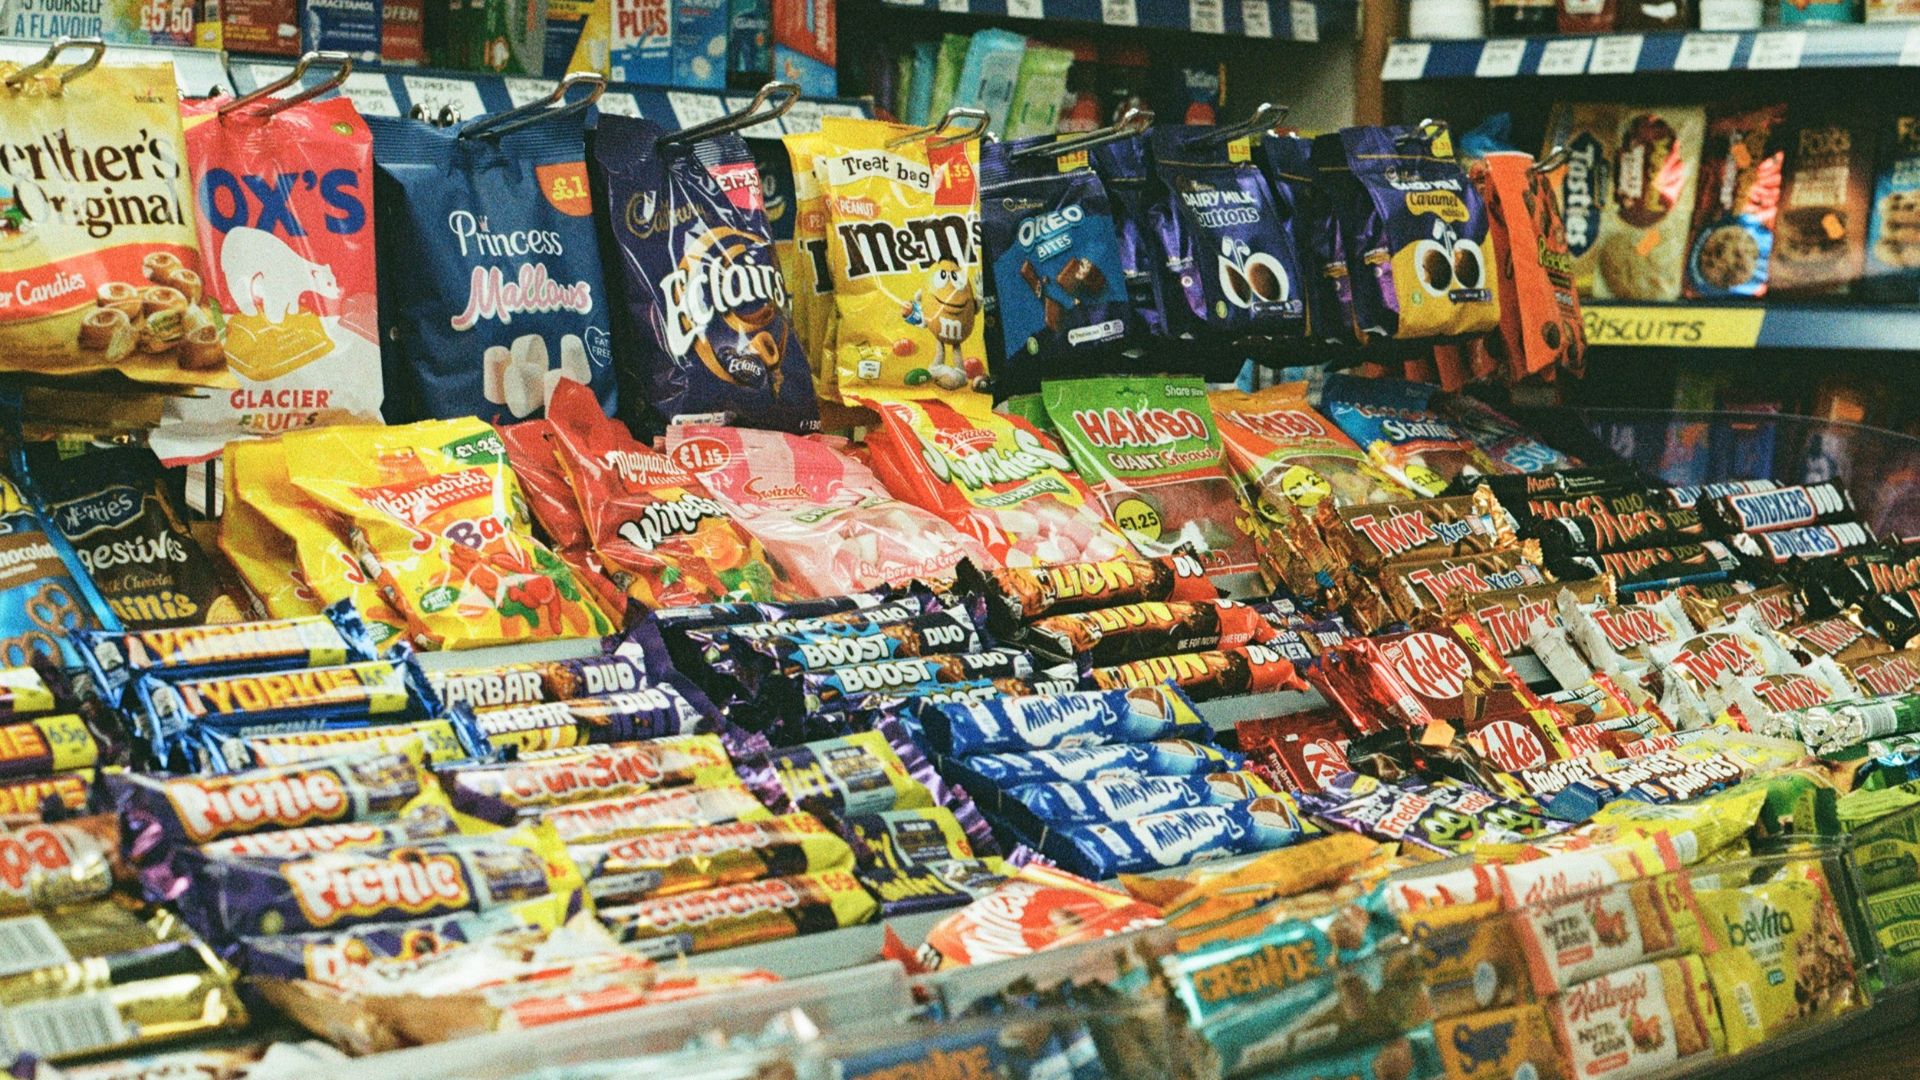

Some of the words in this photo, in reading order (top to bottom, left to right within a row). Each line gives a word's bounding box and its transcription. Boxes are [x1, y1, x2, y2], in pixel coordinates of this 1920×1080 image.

[14, 15, 24, 38] A
[31, 15, 103, 38] FLAVOUR
[618, 8, 668, 38] PLUS
[842, 156, 889, 176] Treat
[896, 163, 931, 188] bag
[551, 175, 588, 201] £1
[202, 169, 366, 237] OX'S
[840, 199, 875, 216] PEANUT
[448, 210, 563, 258] Princess
[1018, 203, 1084, 247] OREO
[1036, 234, 1073, 258] BITES
[16, 271, 87, 306] Candies
[451, 263, 593, 331] Mallows
[660, 254, 786, 355] Eclairs
[1583, 311, 1705, 342] BISCUITS
[728, 359, 762, 377] Eclairs
[230, 389, 330, 409] GLACIER
[1165, 385, 1191, 397] Share
[238, 410, 318, 433] FRUITS
[679, 443, 724, 469] £1.15
[1107, 453, 1165, 471] GIANT
[1735, 486, 1814, 529] SNICKERS
[1806, 483, 1845, 516] DUO
[1119, 511, 1159, 531] £1.25
[1432, 519, 1472, 545] Xtra
[1827, 521, 1867, 546] DUO
[799, 633, 891, 670] BOOST
[922, 624, 966, 648] DUO
[583, 662, 637, 695] DUO
[834, 660, 933, 693] BOOST
[1399, 633, 1468, 699] KitKat
[610, 687, 671, 714] DUO
[1094, 698, 1118, 726] 2
[1174, 781, 1200, 807] 2
[1217, 813, 1245, 840] 2
